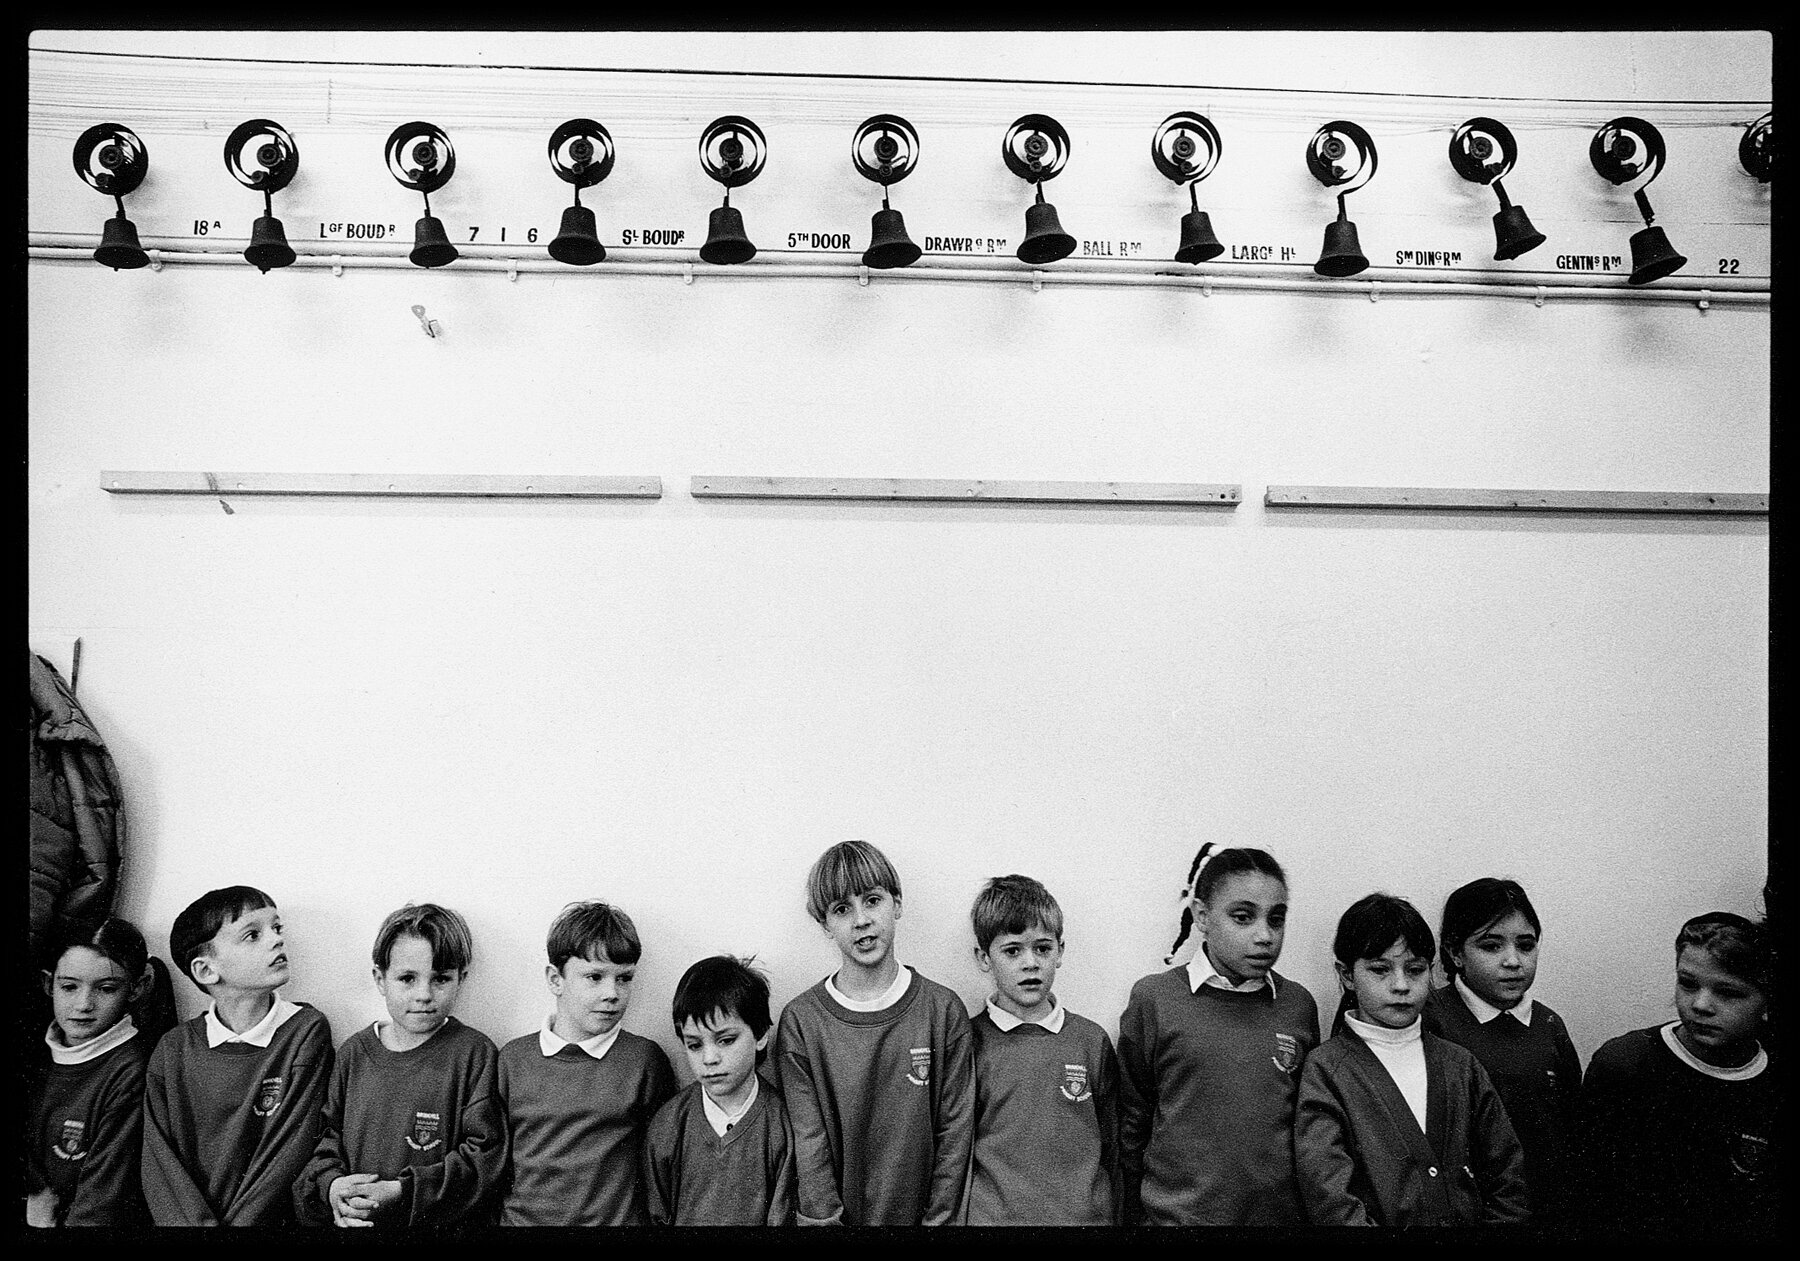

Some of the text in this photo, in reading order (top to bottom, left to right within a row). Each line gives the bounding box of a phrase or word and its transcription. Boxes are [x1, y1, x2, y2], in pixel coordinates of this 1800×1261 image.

[788, 233, 850, 249] 5TH DOOR
[1084, 241, 1112, 255] BALL
[1719, 259, 1739, 274] 22
